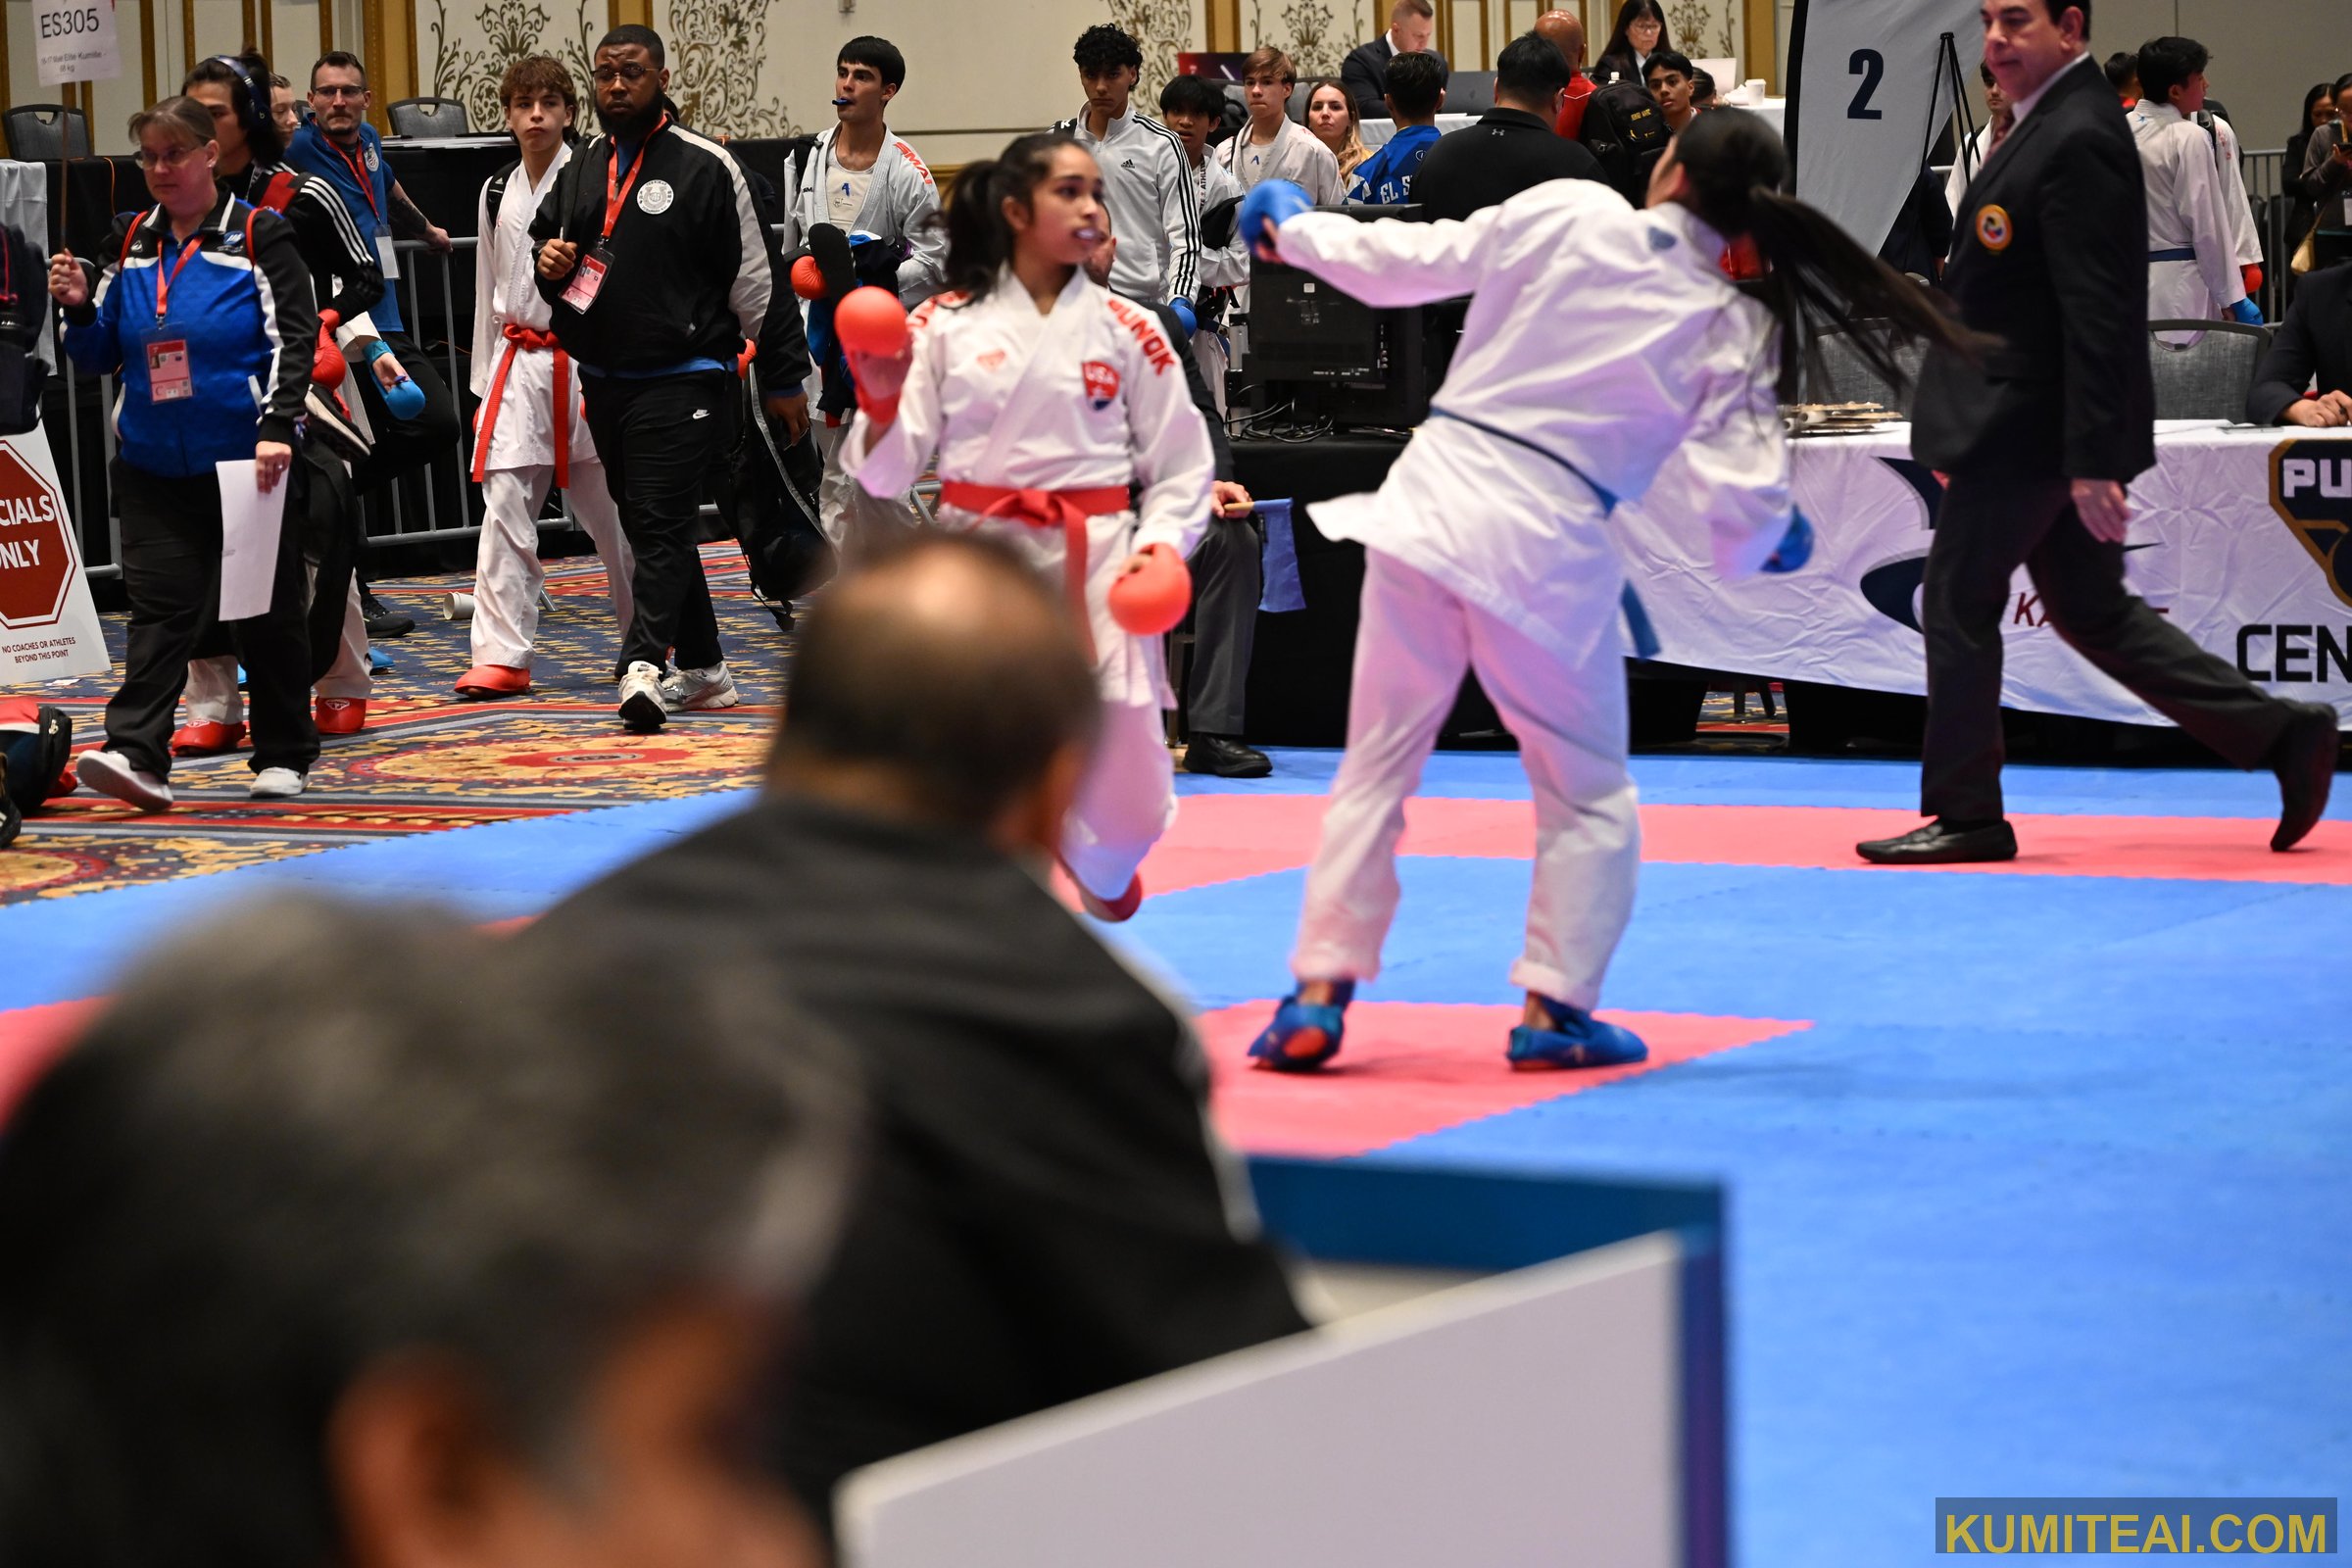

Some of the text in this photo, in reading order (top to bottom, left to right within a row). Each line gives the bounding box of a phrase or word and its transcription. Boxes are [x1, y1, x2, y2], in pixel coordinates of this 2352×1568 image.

[41, 8, 99, 38] ES305
[1847, 48, 1884, 120] 2
[1380, 181, 1398, 204] EL
[2283, 459, 2352, 498] PU
[0, 539, 40, 569] NLY
[2, 637, 76, 654] NO COACHES OR ATHLETES
[15, 653, 37, 663] BEYOND
[52, 649, 69, 659] POINT
[2237, 624, 2352, 683] CEN
